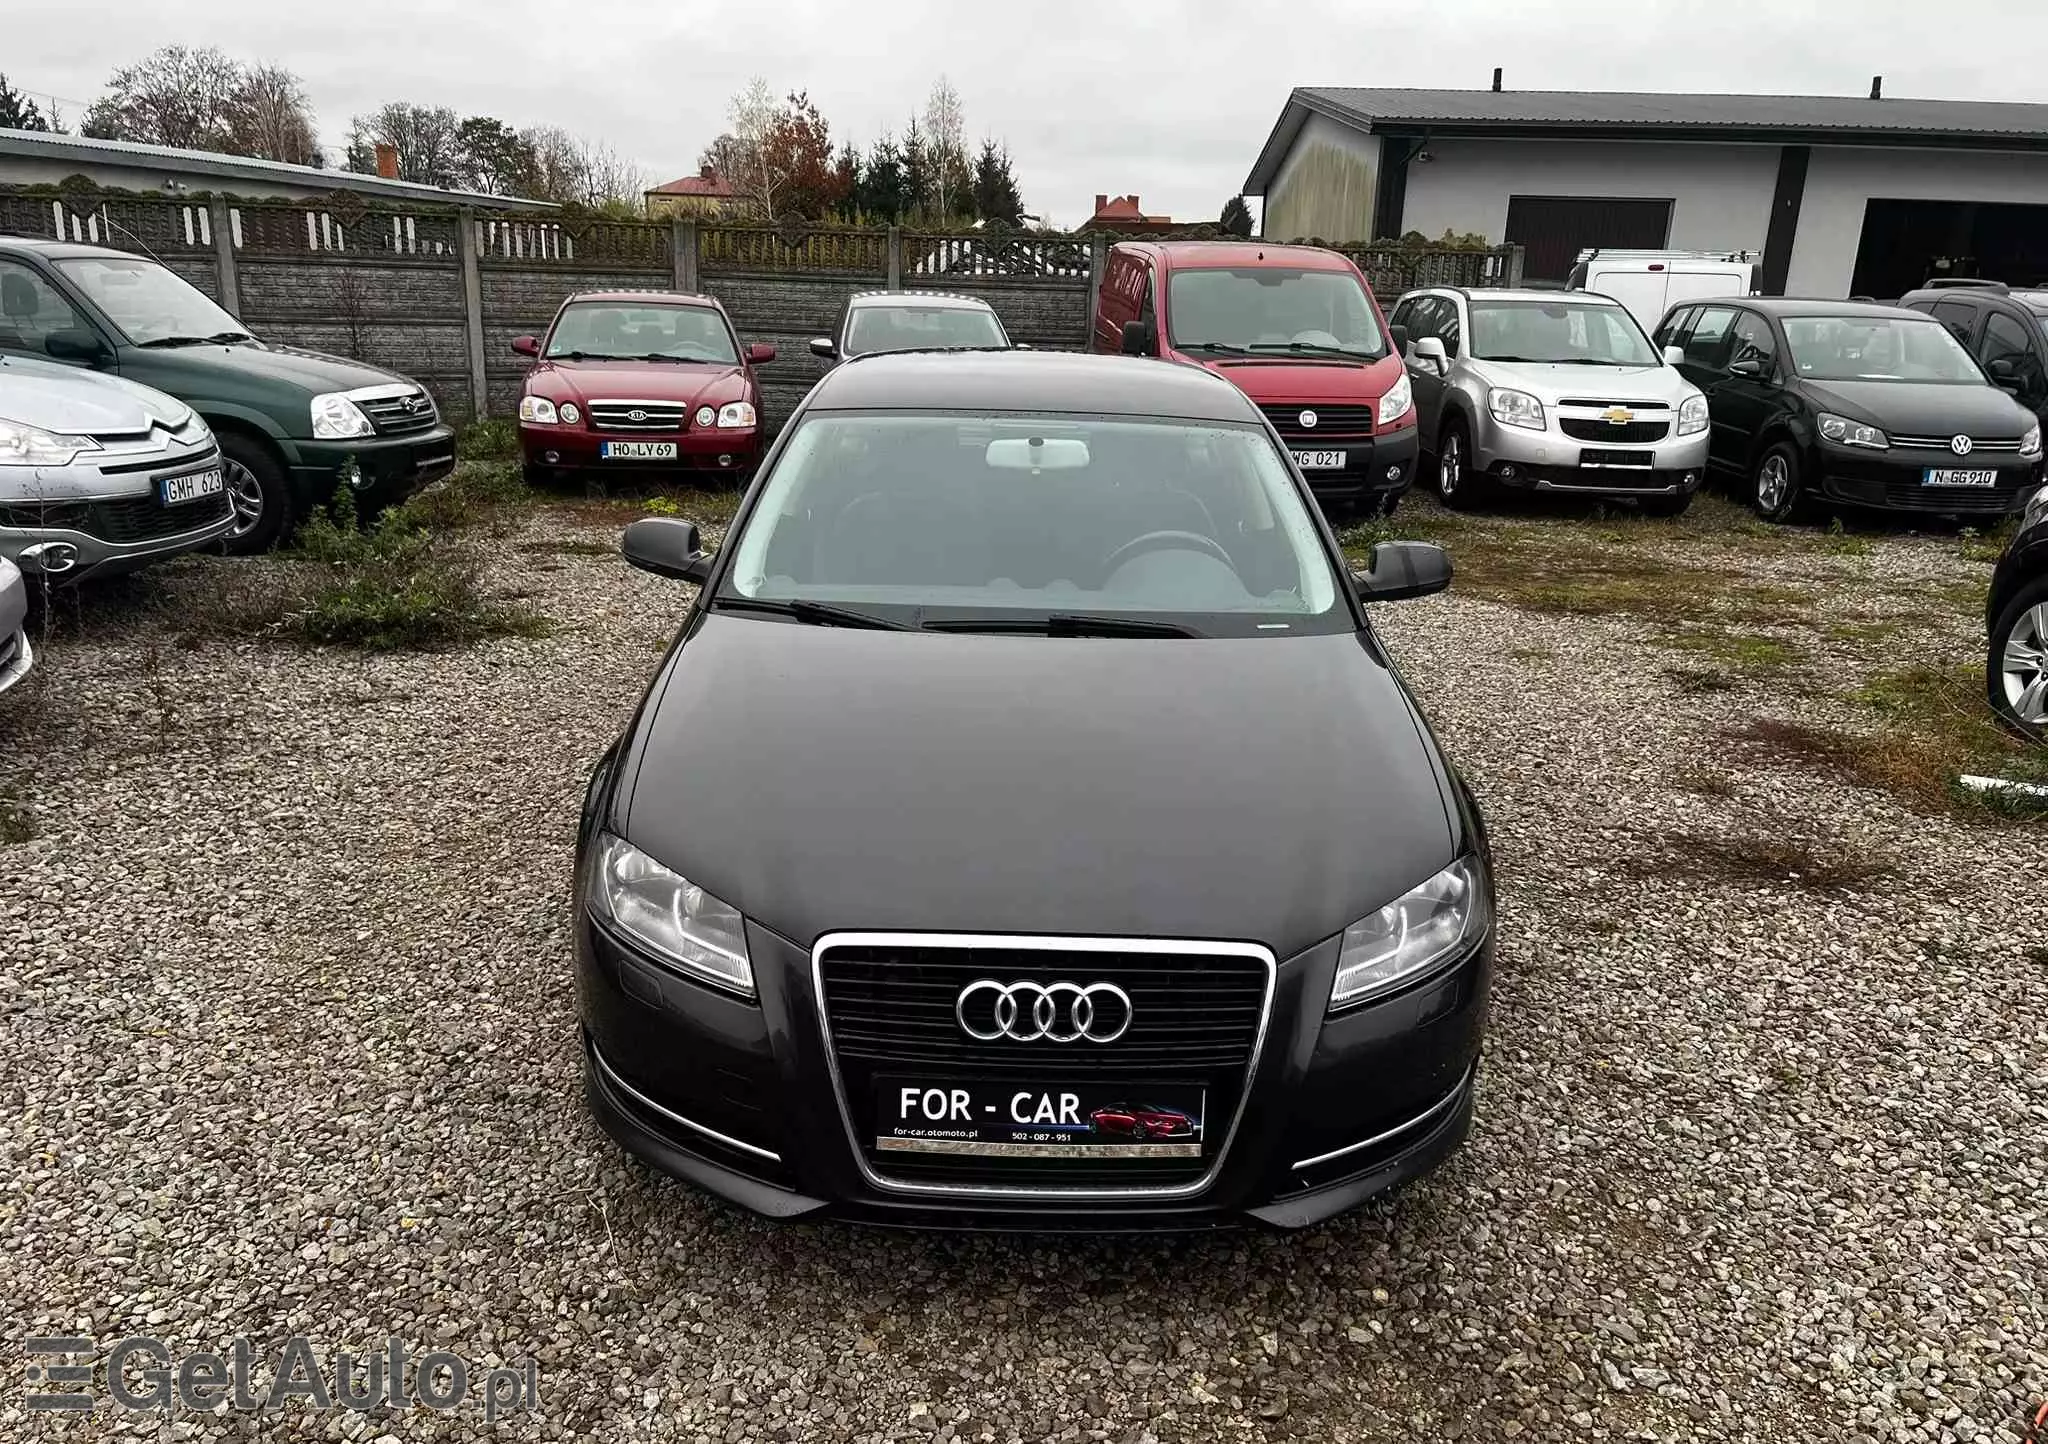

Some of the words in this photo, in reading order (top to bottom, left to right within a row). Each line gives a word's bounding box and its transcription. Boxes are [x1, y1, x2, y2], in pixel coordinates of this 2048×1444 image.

[612, 443, 630, 456] HO
[1316, 452, 1339, 466] 021
[1935, 471, 1945, 483] N
[168, 476, 194, 500] GMH
[202, 471, 221, 493] 623
[900, 1088, 972, 1121] FOR
[1010, 1091, 1081, 1125] CAR
[894, 1127, 978, 1138] for-car.otomoto.pl
